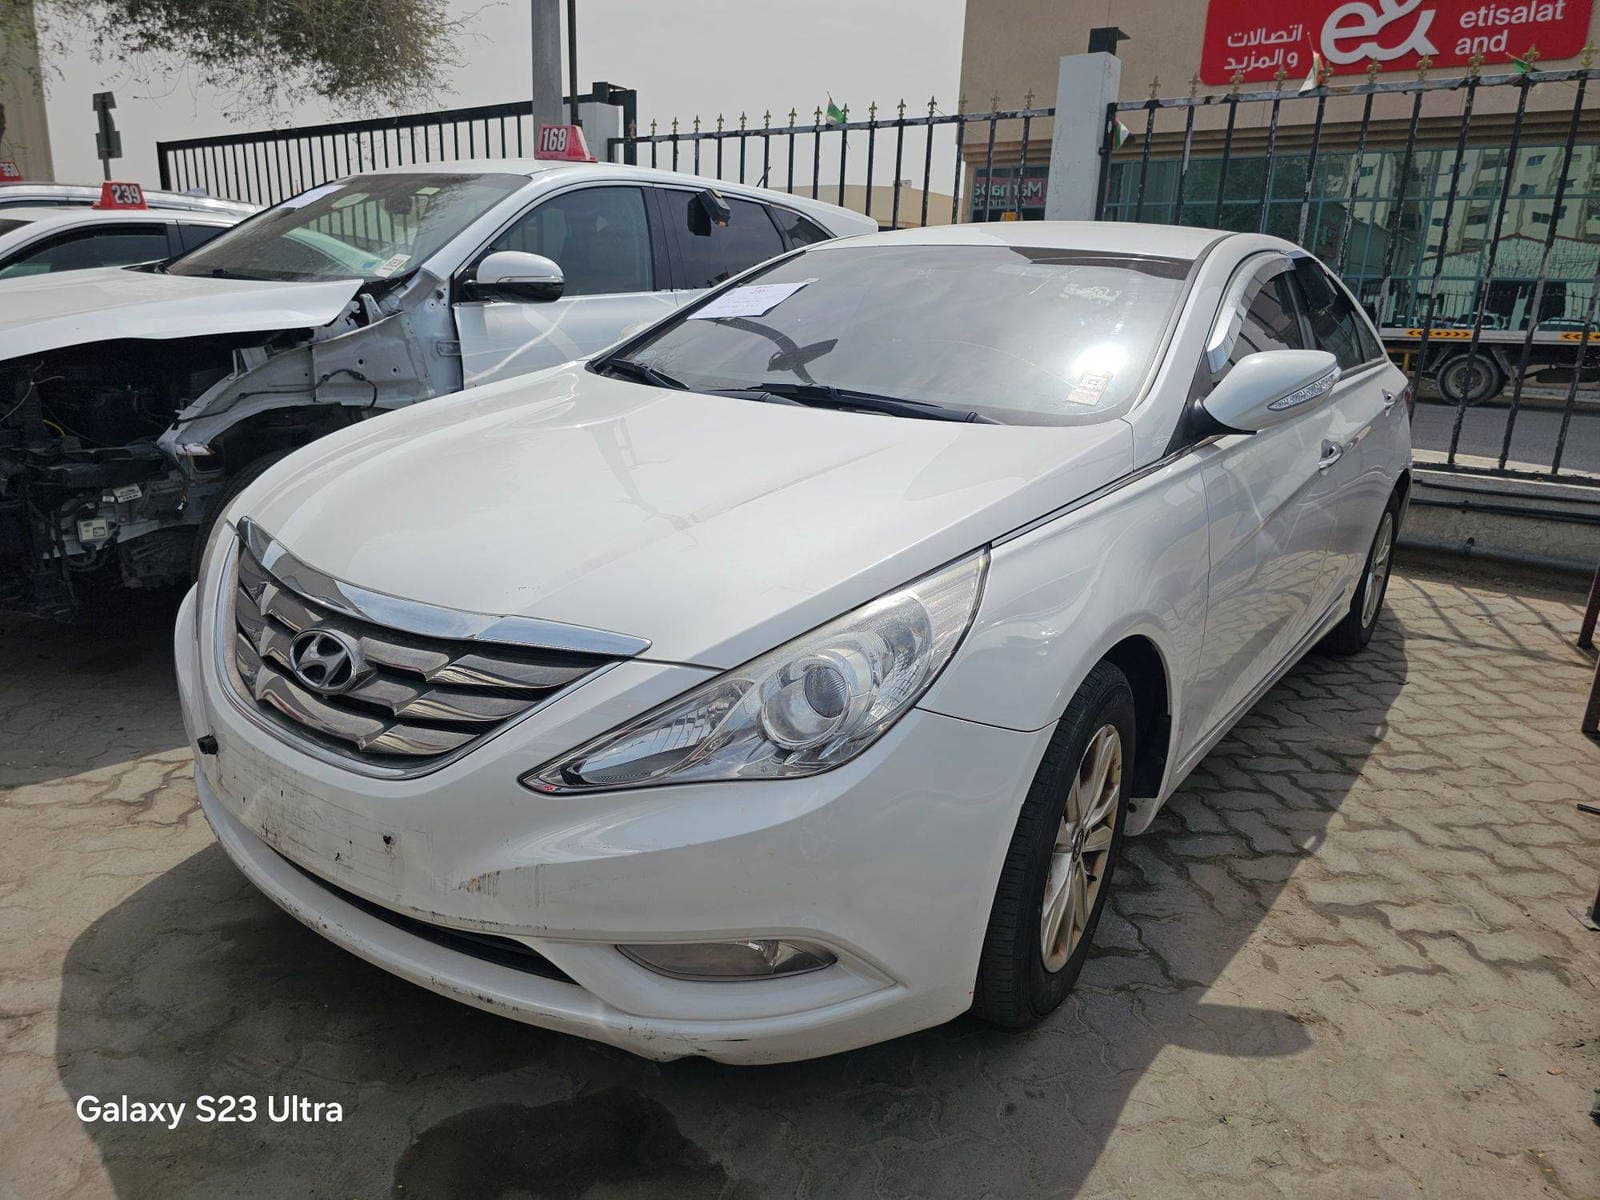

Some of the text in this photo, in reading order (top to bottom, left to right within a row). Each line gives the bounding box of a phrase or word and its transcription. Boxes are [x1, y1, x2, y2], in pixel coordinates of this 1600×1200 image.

[1459, 0, 1566, 28] etisalat
[1227, 24, 1303, 47] اتصالات
[1455, 29, 1509, 55] and
[543, 128, 567, 151] 168
[112, 184, 141, 204] 239
